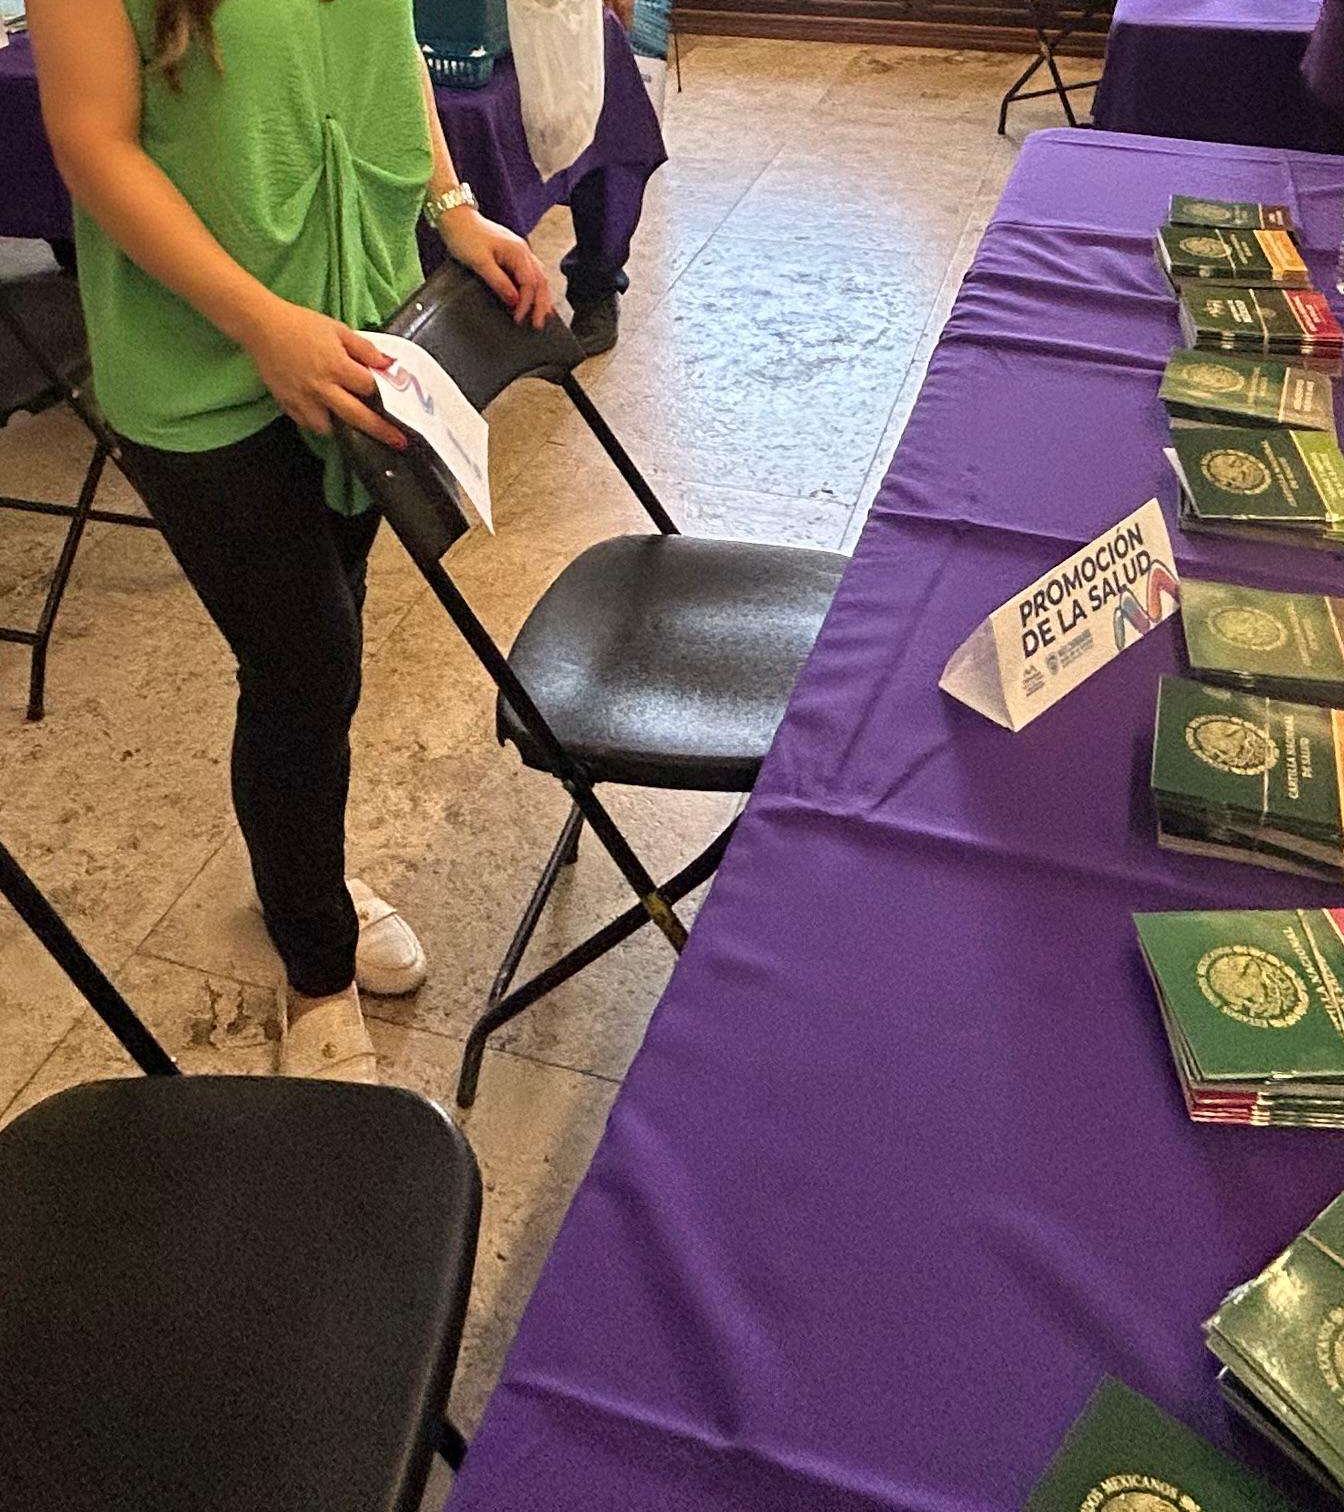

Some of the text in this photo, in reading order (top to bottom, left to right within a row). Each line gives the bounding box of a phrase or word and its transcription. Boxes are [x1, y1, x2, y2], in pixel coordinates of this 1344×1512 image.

[1019, 522, 1144, 628] PROMOCIÓN
[1021, 617, 1056, 659] DE
[1057, 599, 1088, 634] LA
[1088, 549, 1151, 612] SALUD
